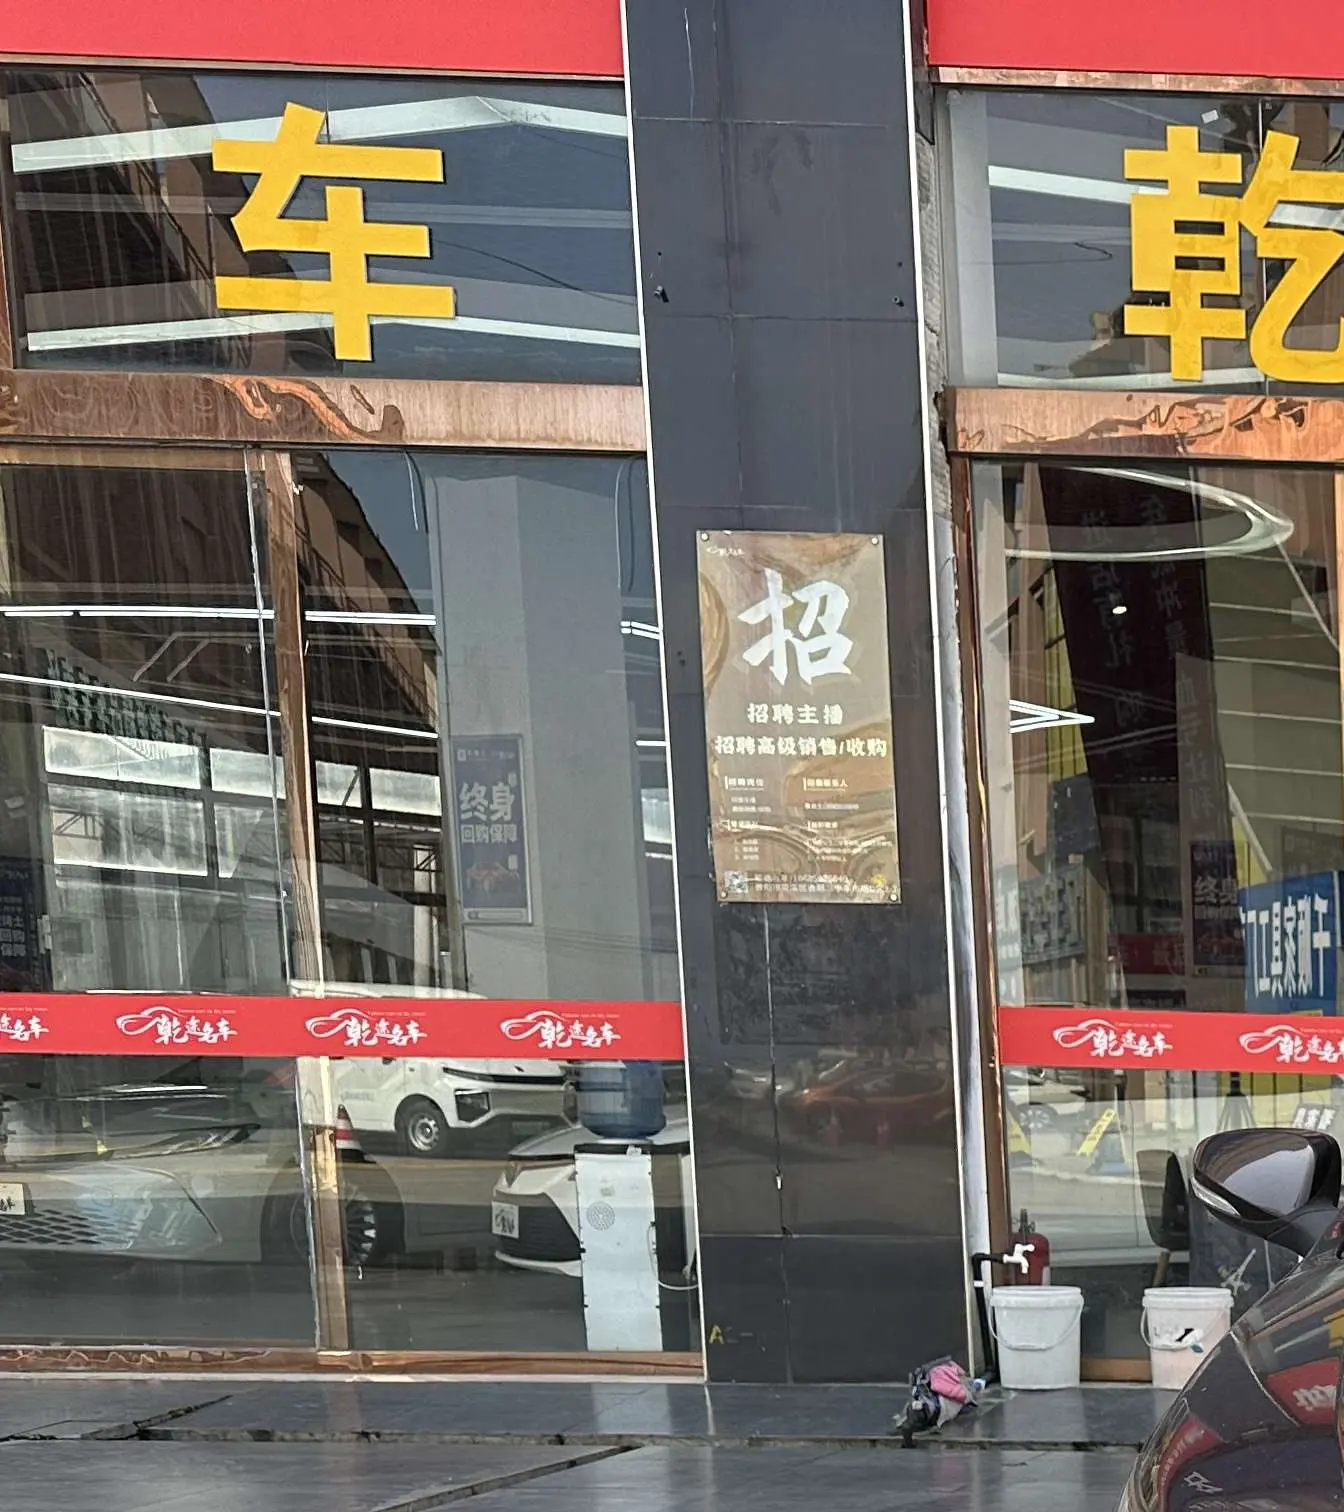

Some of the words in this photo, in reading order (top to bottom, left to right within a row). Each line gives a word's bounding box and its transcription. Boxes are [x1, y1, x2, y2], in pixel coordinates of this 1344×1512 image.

[212, 102, 455, 362] 车
[737, 567, 853, 687] 招
[747, 702, 844, 726] 招聘主播
[714, 735, 888, 759] 招聘高级销售/收购
[459, 780, 516, 822] 终身
[460, 823, 519, 845] 回购保障
